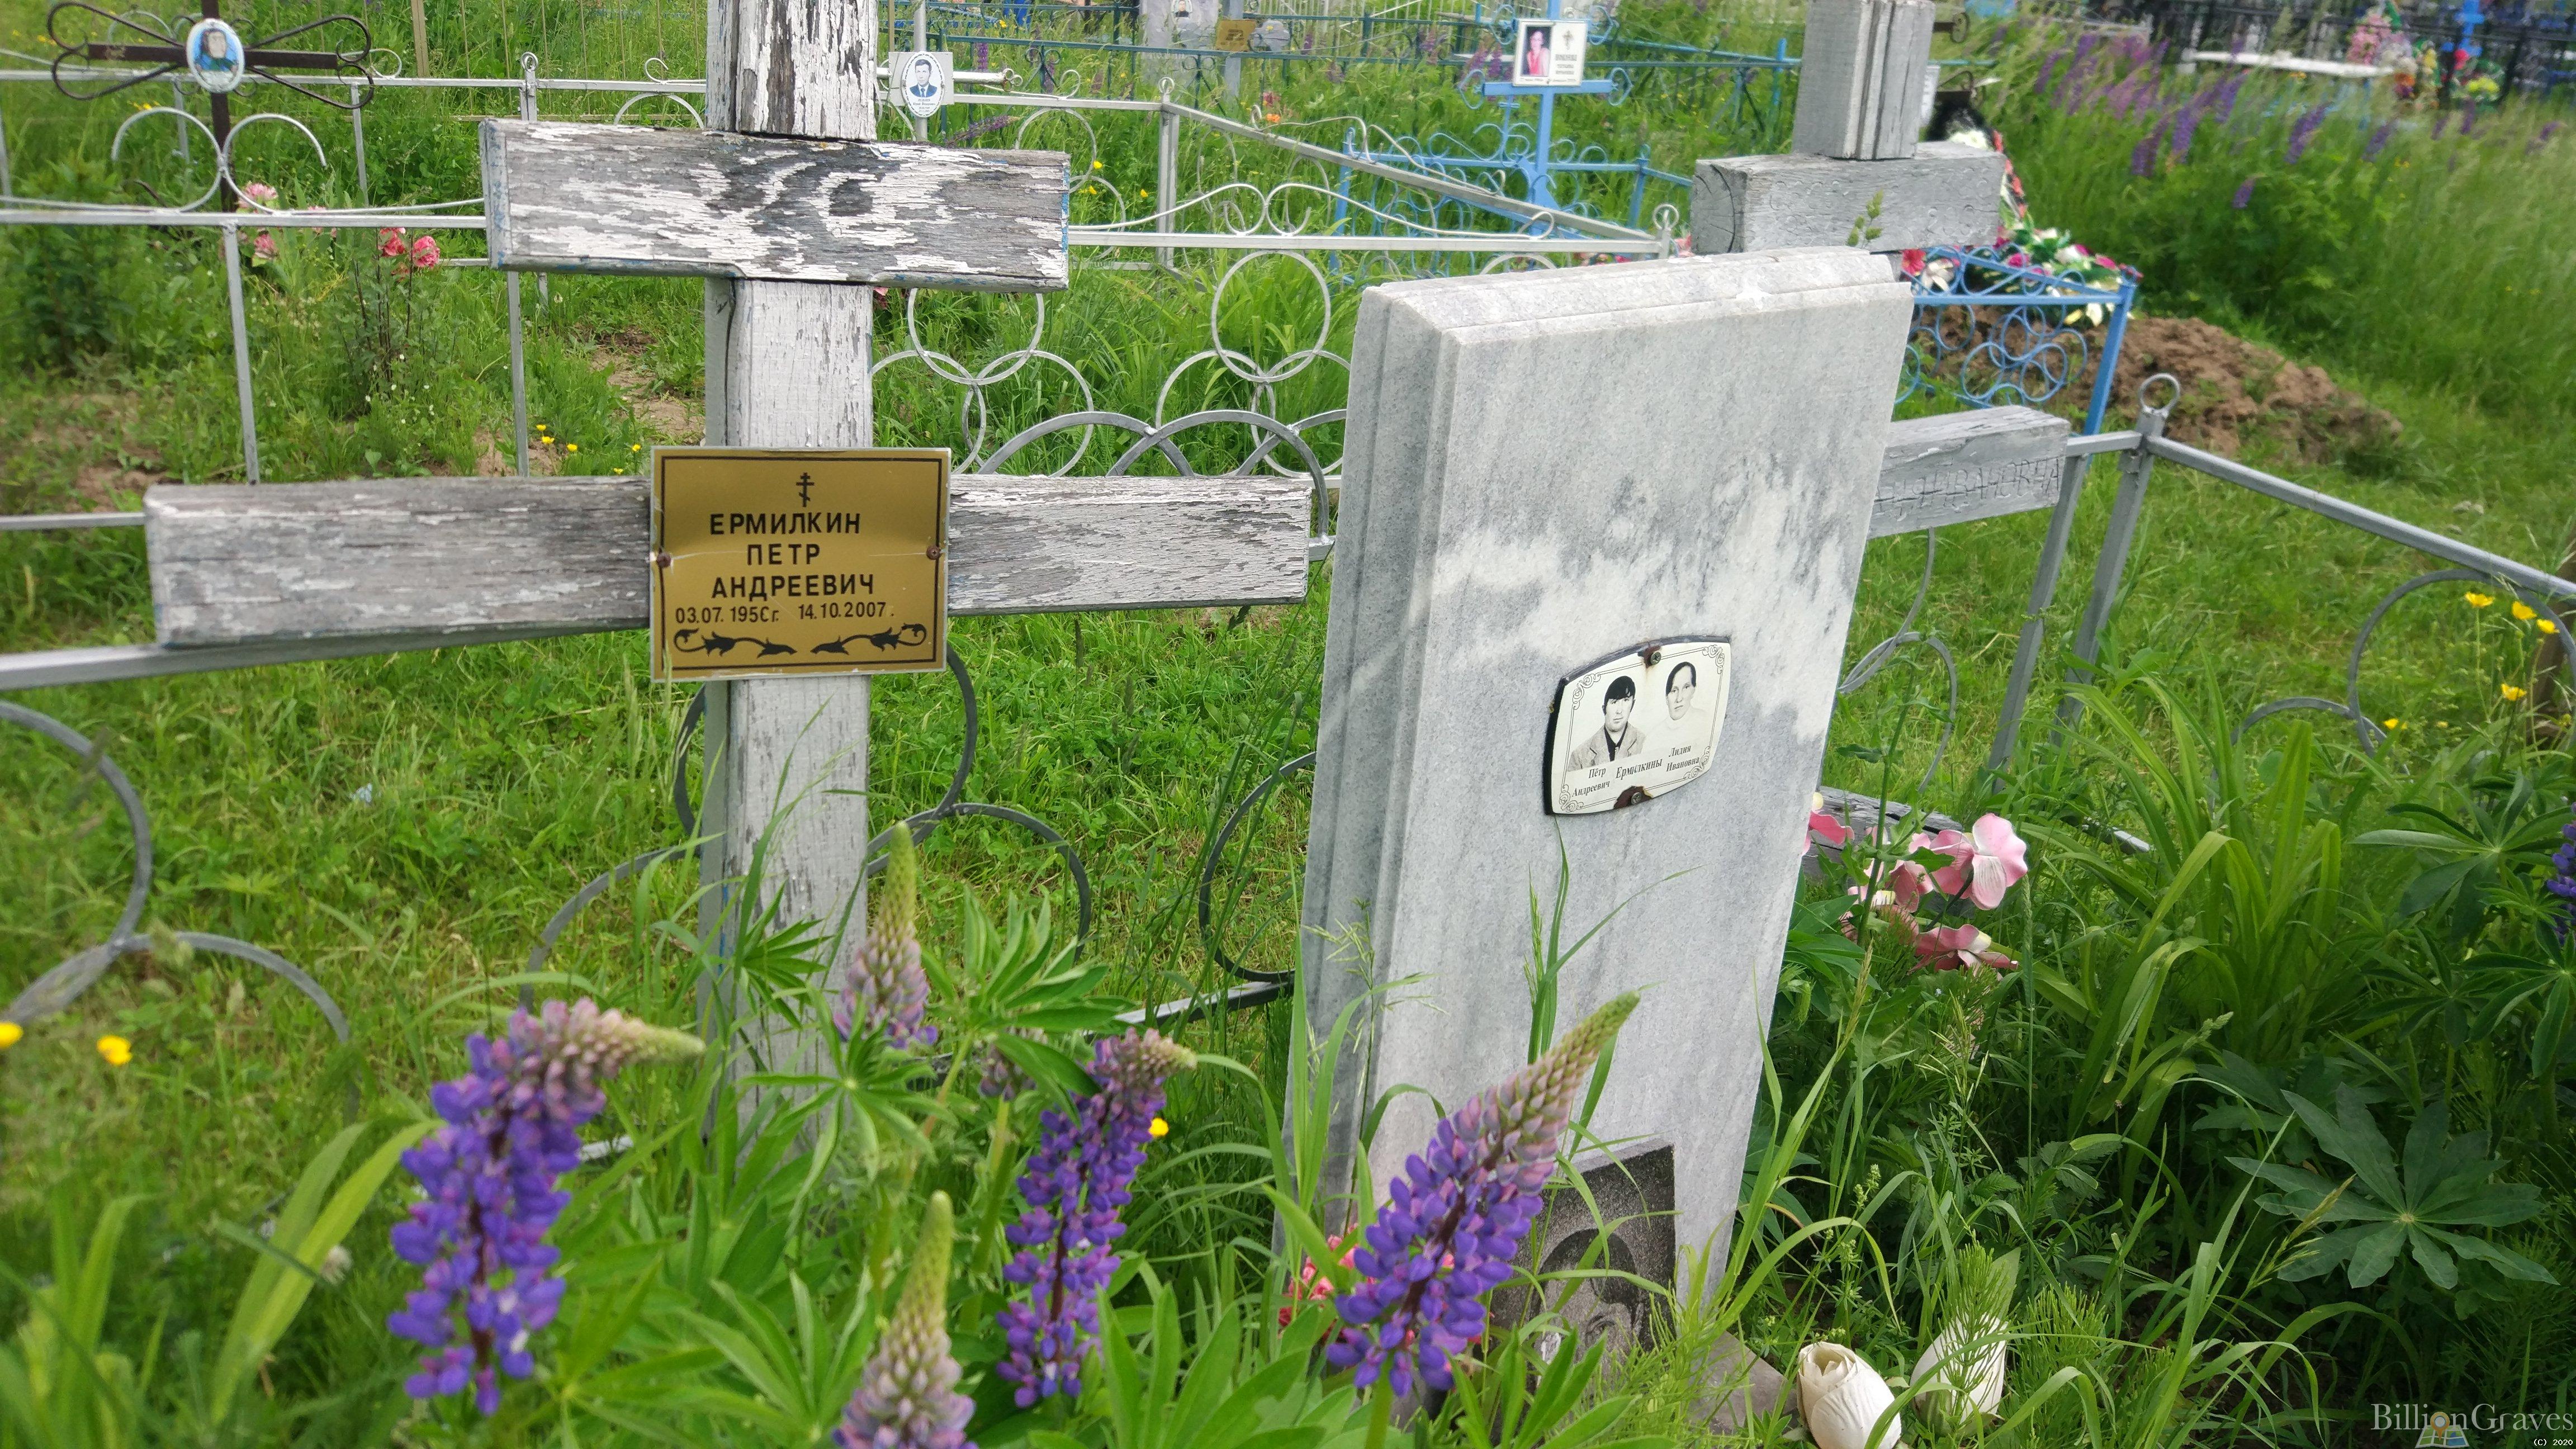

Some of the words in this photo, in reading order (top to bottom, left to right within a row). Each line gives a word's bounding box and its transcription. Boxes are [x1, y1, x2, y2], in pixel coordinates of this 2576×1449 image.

[709, 513, 861, 534] ЕРМИЛКИН
[746, 543, 821, 565] ПЕТР
[712, 574, 874, 602] АНДРЕЕВИЧ
[1668, 745, 1692, 758] Лидия
[1588, 768, 1606, 779] Пётр
[1615, 758, 1663, 780] Ермилкины
[1666, 757, 1700, 772] Ивановна
[1572, 781, 1611, 797] Андреевич
